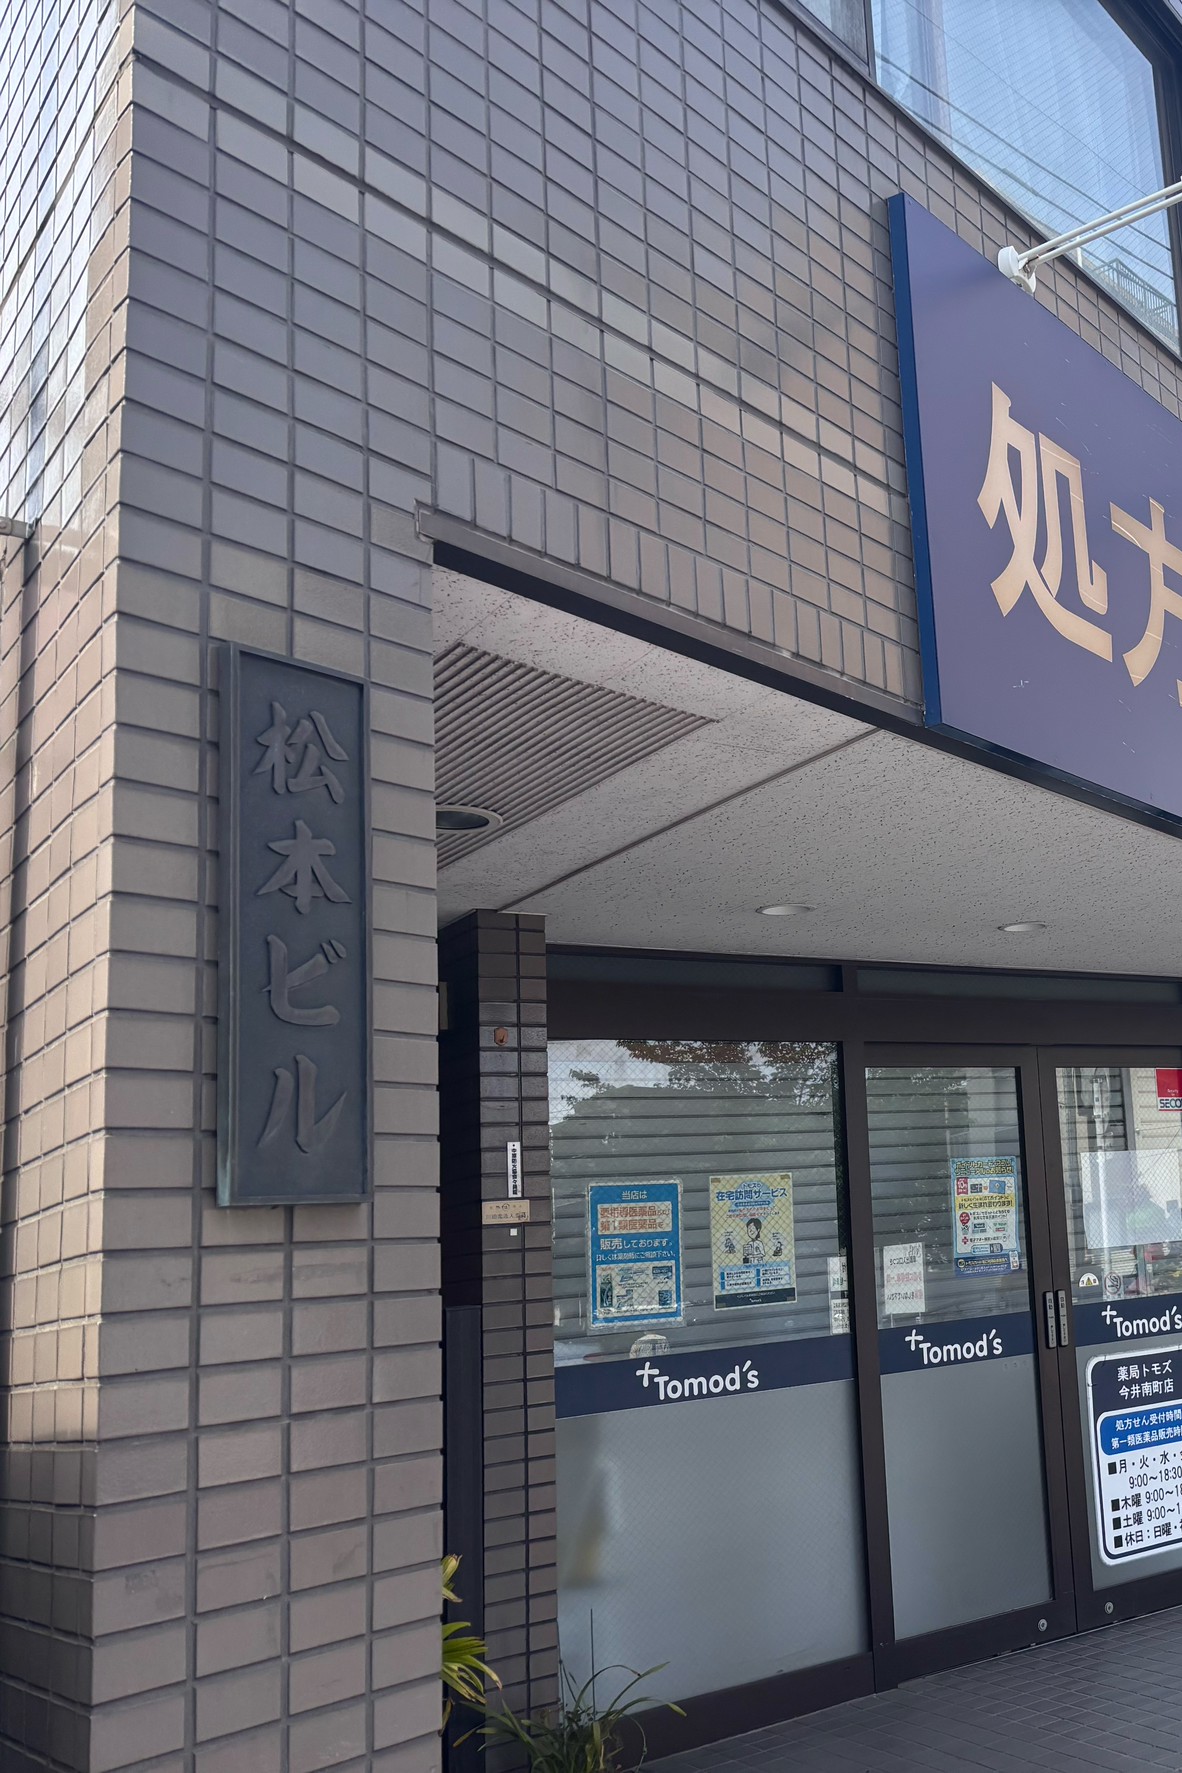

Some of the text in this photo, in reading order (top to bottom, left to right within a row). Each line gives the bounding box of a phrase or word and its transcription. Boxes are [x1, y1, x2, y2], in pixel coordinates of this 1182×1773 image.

[253, 700, 352, 1154] 松本ビル
[621, 1190, 647, 1200] 当店は
[715, 1187, 788, 1201] 在宅訪問サービス
[1113, 1305, 1182, 1338] Tomod's
[921, 1329, 1003, 1365] Tomod's
[654, 1359, 760, 1400] Tomod's
[1117, 1360, 1173, 1382] 薬局トモズ
[1118, 1378, 1174, 1400] 今井南町店
[1115, 1409, 1182, 1431] 処方せん受付時間
